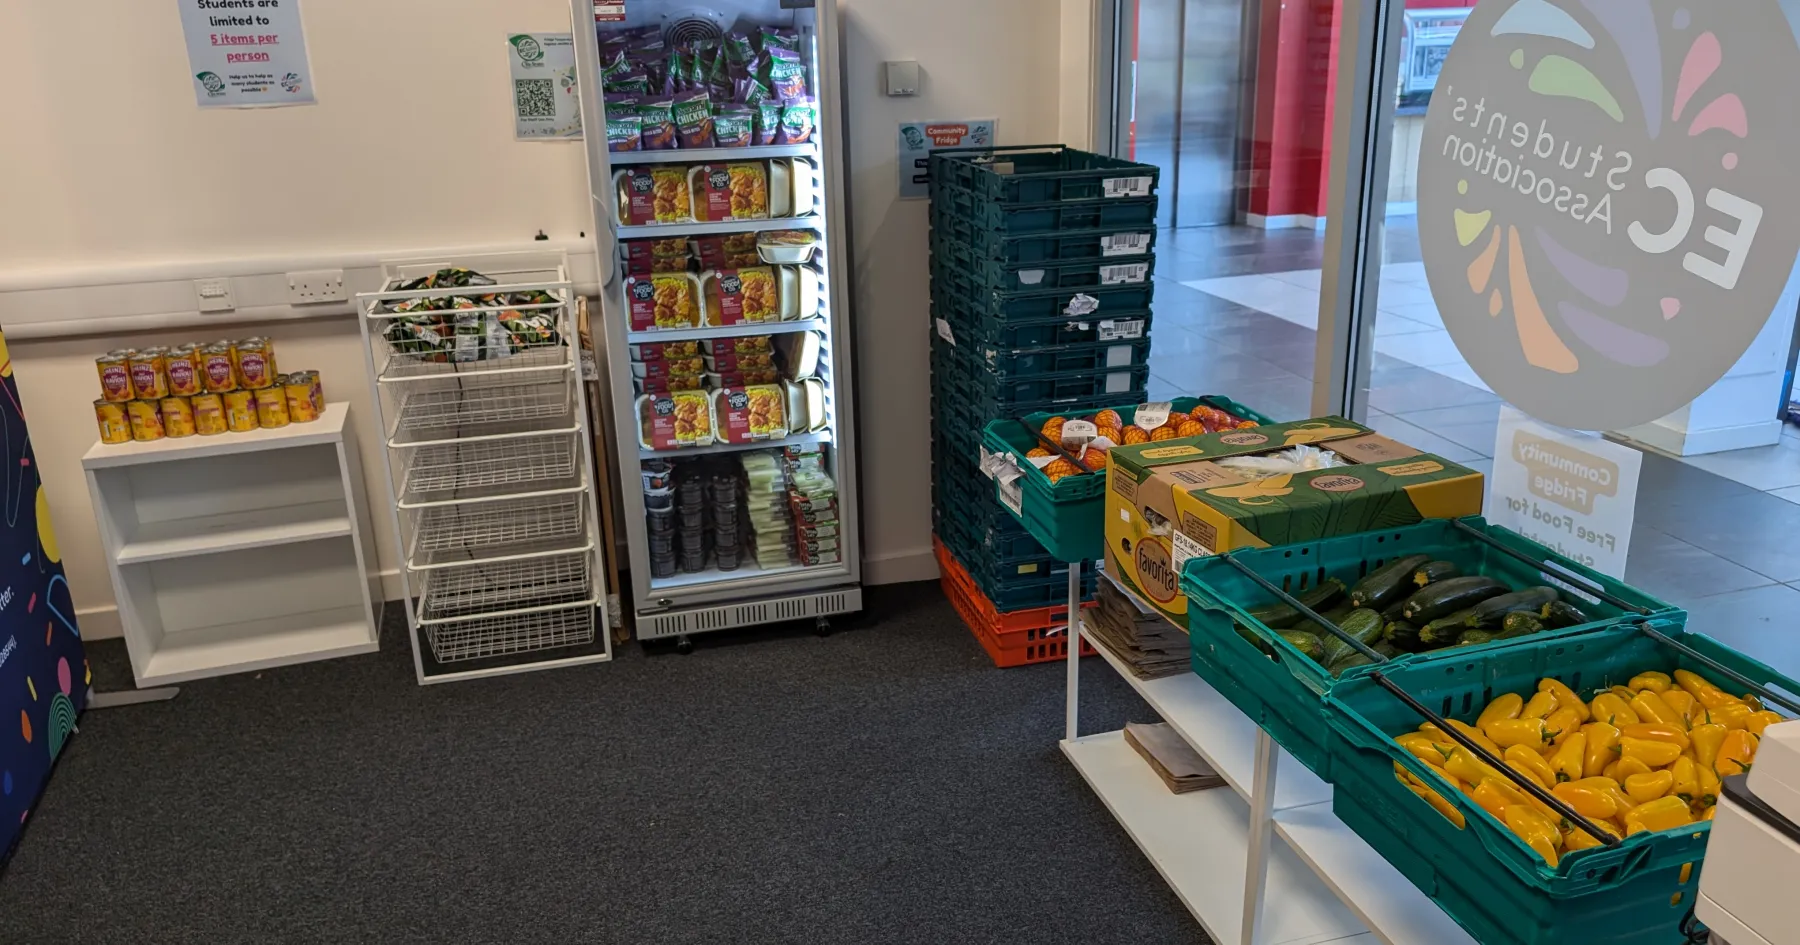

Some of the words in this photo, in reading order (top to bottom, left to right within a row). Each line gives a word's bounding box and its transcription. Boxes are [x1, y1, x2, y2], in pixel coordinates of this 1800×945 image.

[198, 0, 254, 9] Students
[258, 0, 279, 8] are
[209, 15, 253, 27] limited
[256, 15, 270, 26] to
[210, 34, 218, 45] 5
[221, 33, 255, 45] items
[258, 34, 279, 46] per
[227, 52, 270, 63] person
[677, 109, 709, 125] CHICKEN
[606, 128, 638, 136] CHICKEN
[716, 126, 748, 135] CHICKEN
[927, 126, 966, 135] Community
[936, 137, 958, 145] Fridge
[1139, 547, 1175, 591] favorita
